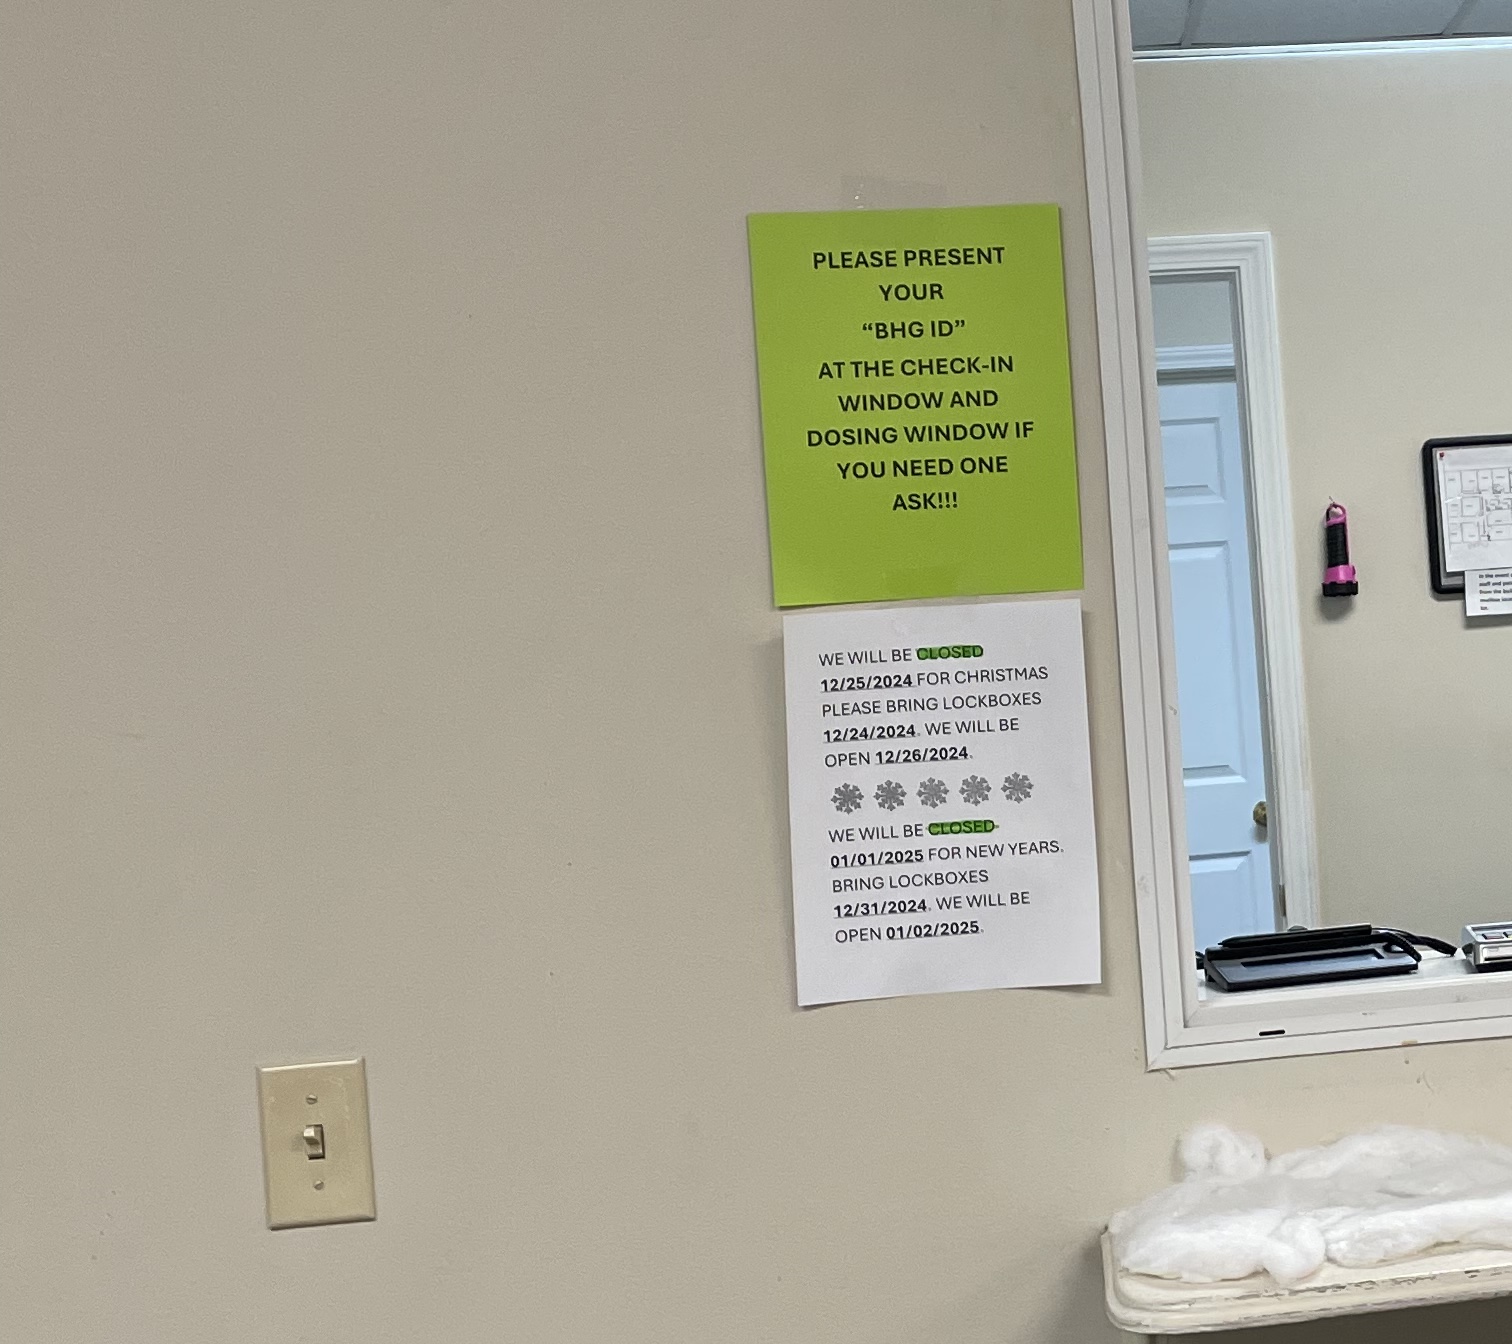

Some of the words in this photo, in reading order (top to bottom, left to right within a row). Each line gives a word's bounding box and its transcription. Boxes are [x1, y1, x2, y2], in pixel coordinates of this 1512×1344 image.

[814, 251, 897, 269] PLEASE
[904, 247, 1004, 266] PRESENT
[879, 284, 944, 301] YOUR
[819, 362, 845, 379] AT
[850, 360, 894, 377] THE
[901, 356, 1013, 376] CHECK-IN
[838, 392, 943, 411] WINDOW
[950, 390, 998, 408] AND
[808, 428, 897, 446] DOSING
[904, 423, 1008, 442] WINDOW
[1016, 422, 1033, 438] IF
[837, 461, 885, 479] YOU
[893, 459, 953, 477] NEED
[961, 456, 1008, 474] ONE
[893, 492, 957, 510] ASK!!!
[819, 653, 844, 666] WE
[848, 650, 887, 664] WILL
[892, 649, 912, 662] BE
[917, 645, 983, 661] CLOSED
[821, 674, 913, 691] 12/25/2024
[917, 672, 950, 686] FOR
[955, 667, 1048, 683] CHRISTMAS
[823, 701, 881, 717] PLEASE
[887, 698, 938, 713] BRING
[943, 692, 1041, 709] LOCKBOXES
[925, 722, 951, 735] WE
[955, 720, 995, 733] WILL
[1000, 718, 1019, 731] BE
[825, 752, 870, 767] OPEN
[875, 747, 973, 764] 12/26/2024.
[828, 828, 855, 842] WE
[859, 826, 899, 840] WILL
[904, 824, 923, 837] BE
[927, 820, 995, 835] CLOSED
[831, 849, 923, 867] 01/01/2025
[929, 847, 961, 860] FOR
[966, 844, 1004, 858] NEW
[1008, 841, 1063, 855] YEARS.
[833, 877, 884, 892] BRING
[889, 870, 988, 888] LOCKBOXES
[936, 896, 962, 910] WE
[966, 893, 1006, 907] WILL
[1011, 892, 1030, 905] BE
[836, 927, 881, 943] OPEN
